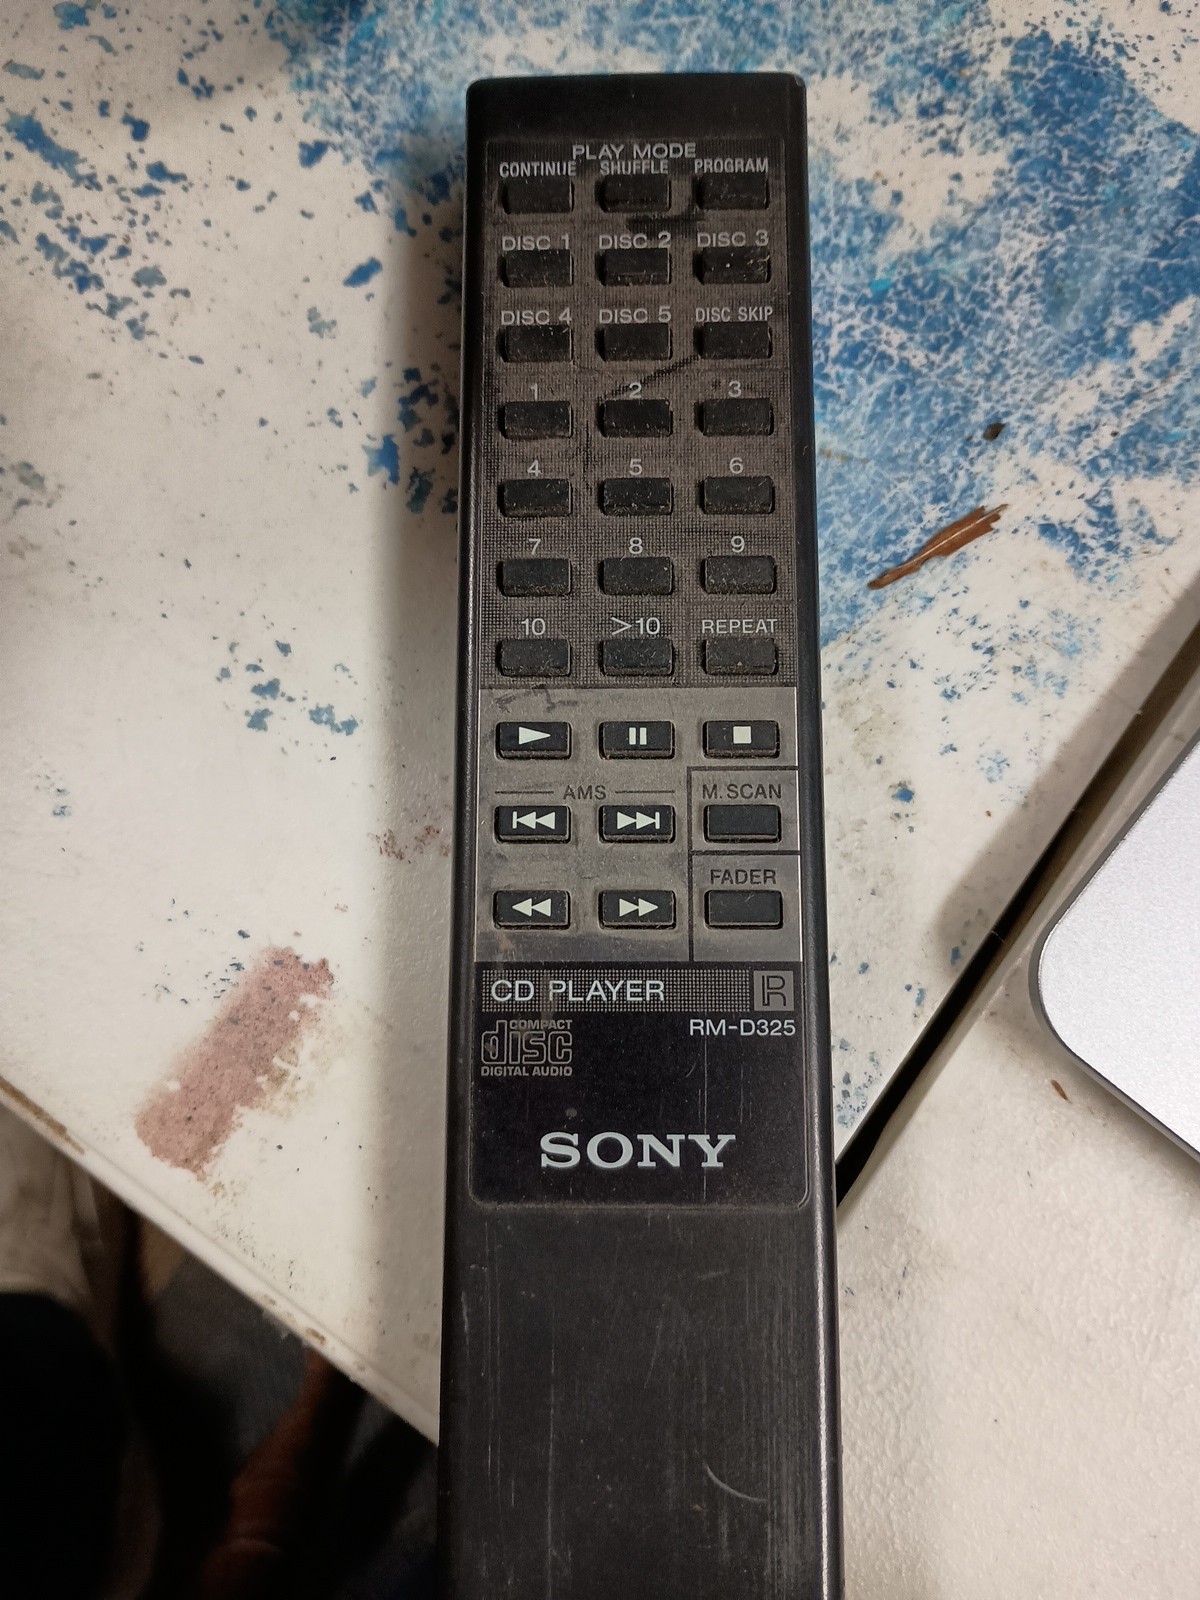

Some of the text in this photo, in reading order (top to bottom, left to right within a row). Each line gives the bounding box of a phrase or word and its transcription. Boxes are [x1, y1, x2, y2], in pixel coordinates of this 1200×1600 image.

[572, 142, 696, 160] PLAY MODE
[500, 161, 577, 178] CONTINUE
[600, 159, 669, 176] SHUFFLE
[695, 157, 769, 174] PROGRAM
[502, 233, 571, 251] DISC 1
[600, 231, 672, 249] DISC 2
[697, 229, 769, 248] DISC 3
[501, 308, 572, 325] DISC 4
[600, 306, 672, 324] DISC 5
[695, 306, 773, 322] DISC SKIP
[529, 383, 539, 400] 1
[629, 382, 642, 399] 2
[728, 381, 742, 398] 3
[527, 460, 541, 477] 4
[629, 458, 642, 475] 5
[729, 457, 743, 474] 6
[528, 538, 541, 555] 7
[628, 537, 643, 554] 8
[731, 536, 745, 553] 9
[521, 618, 546, 635] 10
[701, 618, 778, 634] REPEAT
[563, 785, 607, 800] AMS
[710, 869, 777, 884] FADER
[490, 980, 665, 1001] CD PLAYER
[509, 1019, 573, 1030] COMPACT
[689, 1019, 796, 1037] RM-D325
[481, 1066, 573, 1076] DIGITAL AUDIO
[540, 1131, 736, 1169] SONY
